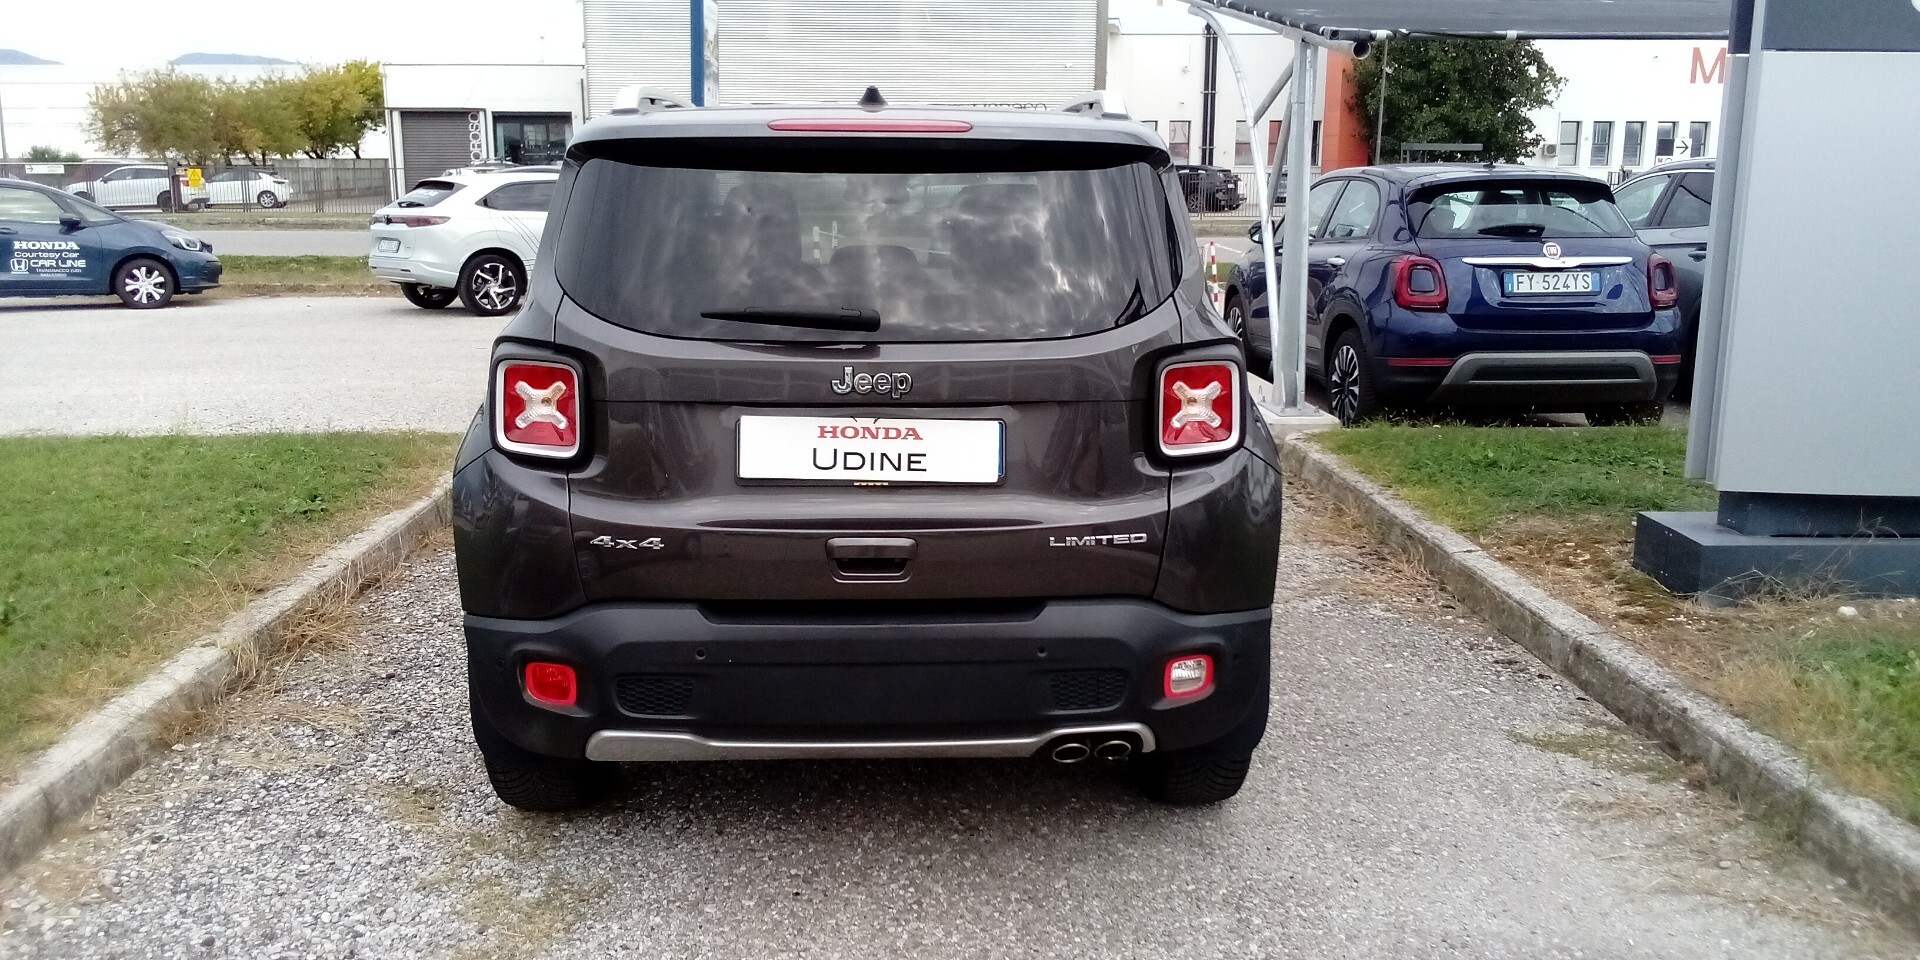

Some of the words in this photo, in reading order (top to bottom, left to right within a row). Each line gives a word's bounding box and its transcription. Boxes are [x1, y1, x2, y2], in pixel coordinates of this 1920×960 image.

[13, 241, 80, 250] HONDA
[14, 251, 60, 259] Courtesy
[30, 259, 56, 267] CAR
[59, 259, 86, 267] LINE
[1516, 274, 1535, 291] FY
[1542, 273, 1590, 290] 524YS
[830, 366, 914, 398] Jeep
[817, 425, 923, 441] HONDA
[812, 447, 928, 473] UDINE
[589, 535, 665, 550] 4x4
[1048, 532, 1148, 547] LIMITED
